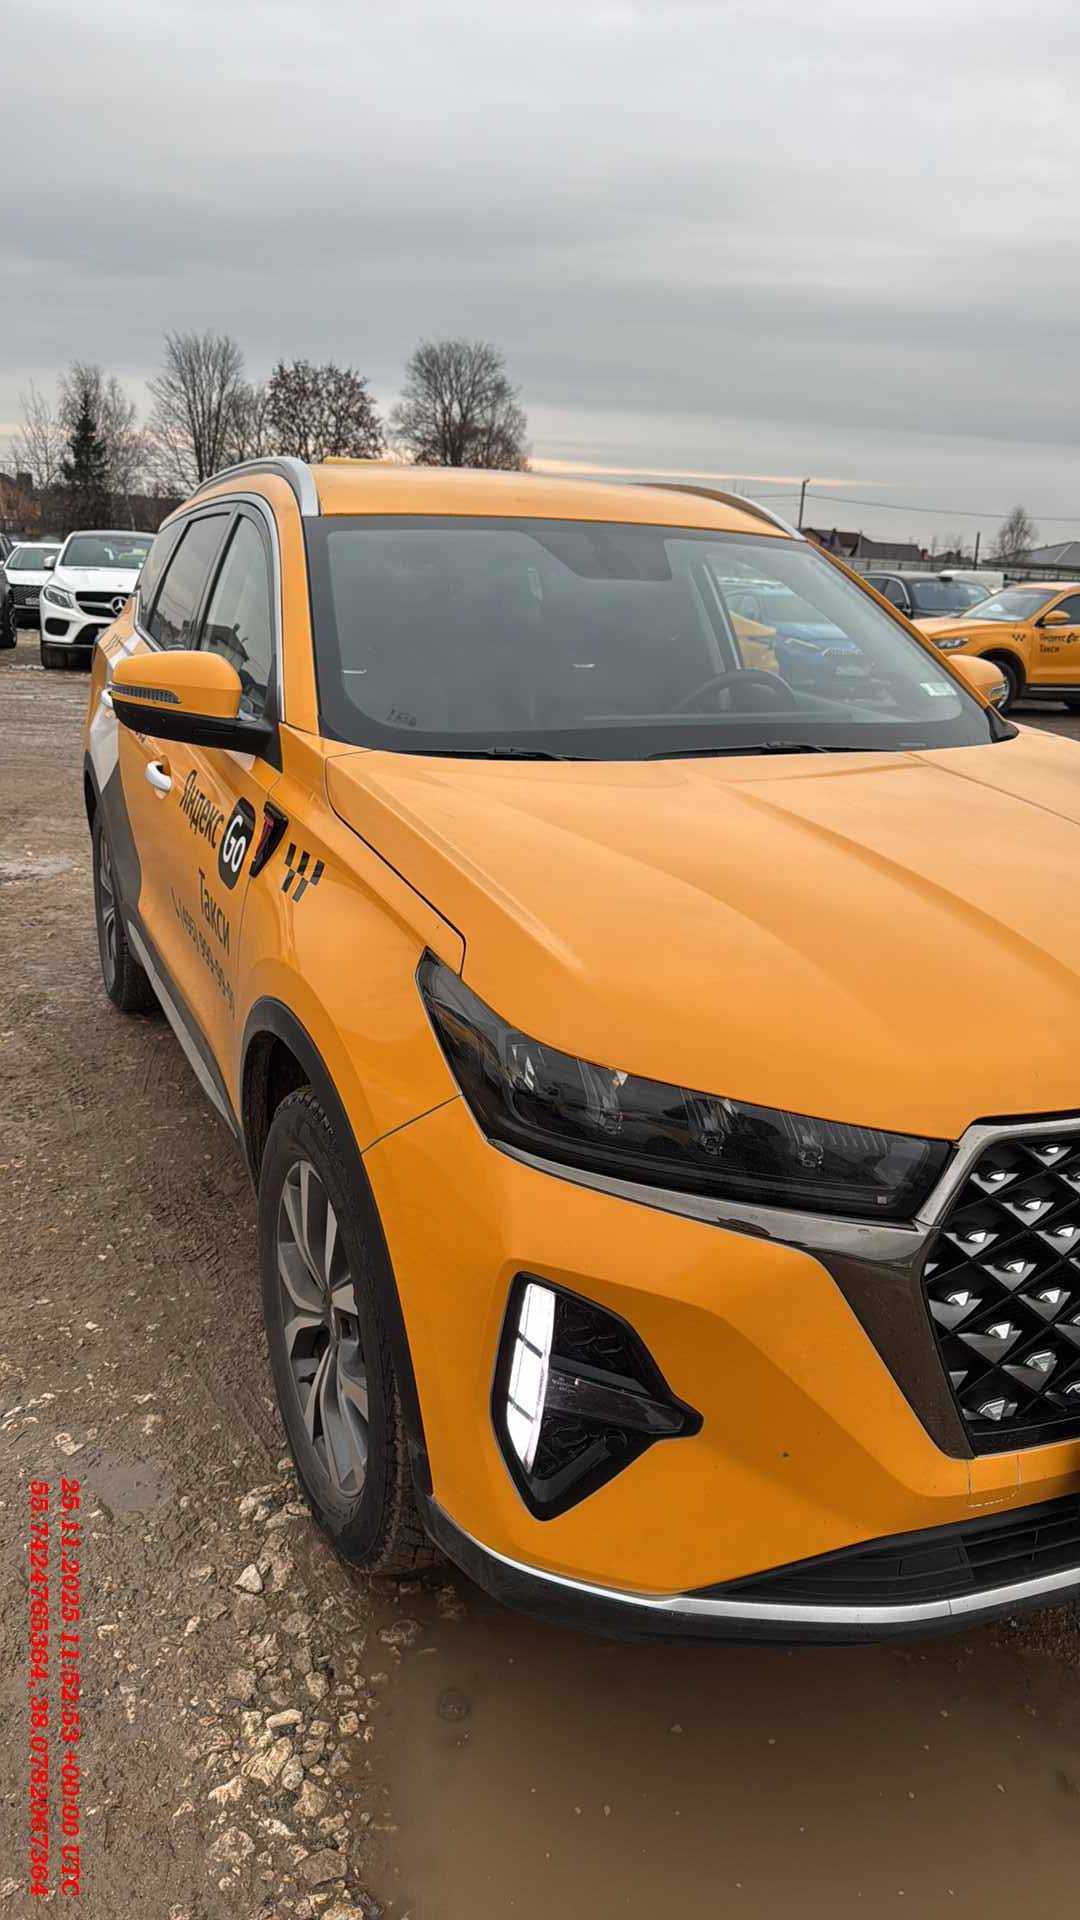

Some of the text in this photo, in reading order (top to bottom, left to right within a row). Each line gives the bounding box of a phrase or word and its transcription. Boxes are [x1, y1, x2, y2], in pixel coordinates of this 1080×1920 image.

[179, 769, 225, 849] Яндекс
[222, 814, 247, 873] Go
[198, 866, 231, 955] Такси
